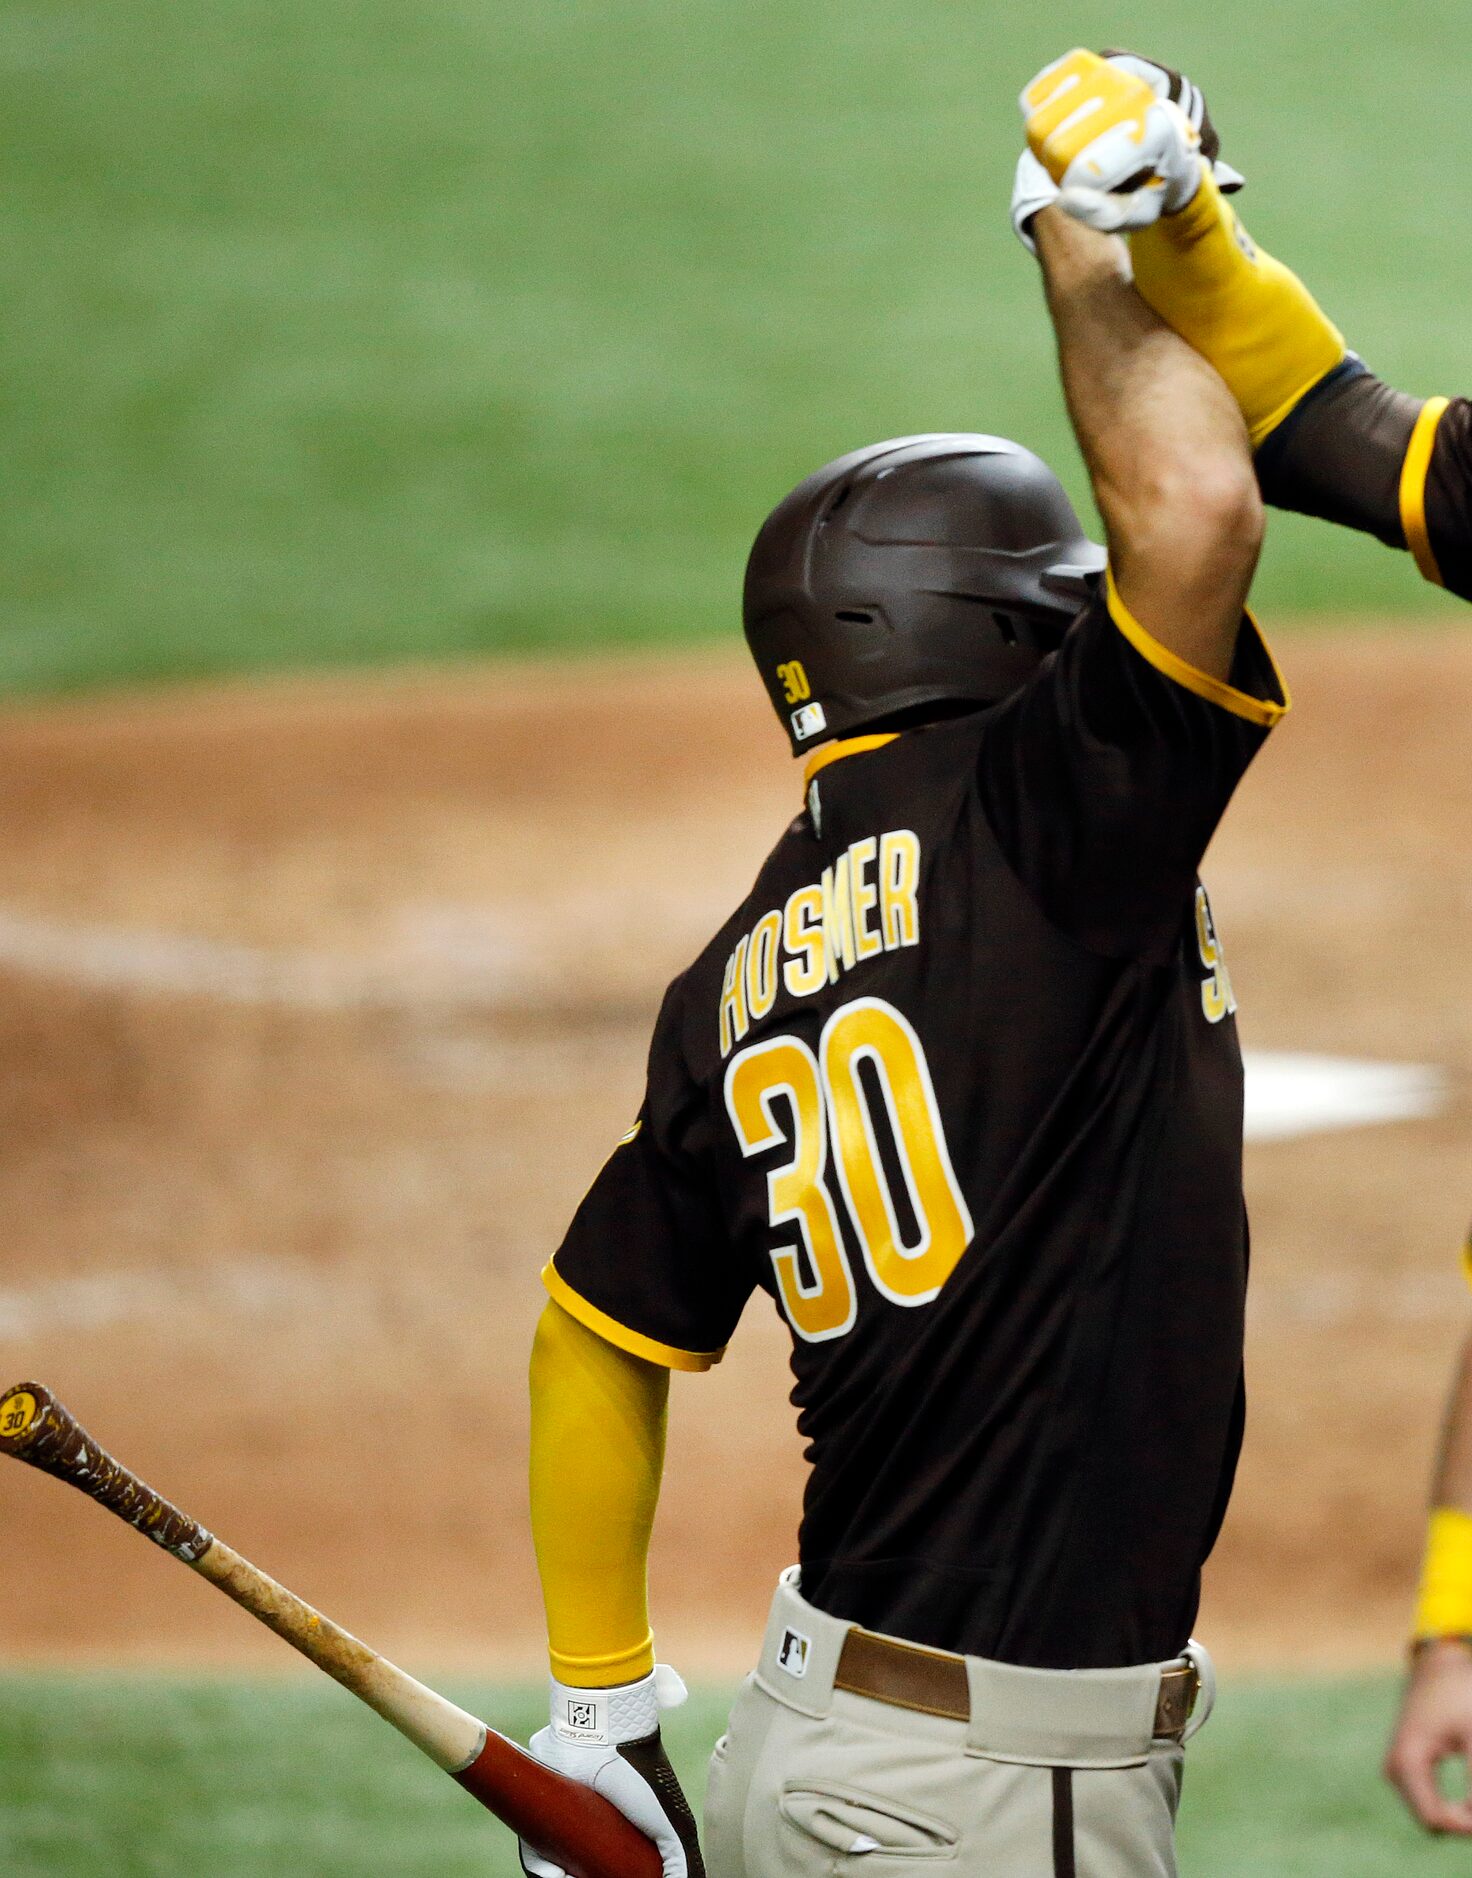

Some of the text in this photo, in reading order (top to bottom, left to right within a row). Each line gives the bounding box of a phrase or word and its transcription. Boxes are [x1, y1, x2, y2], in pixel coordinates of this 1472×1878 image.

[776, 660, 811, 704] 30
[719, 829, 921, 1058] HOSMER
[723, 996, 976, 1343] 30
[3, 1411, 25, 1431] 30
